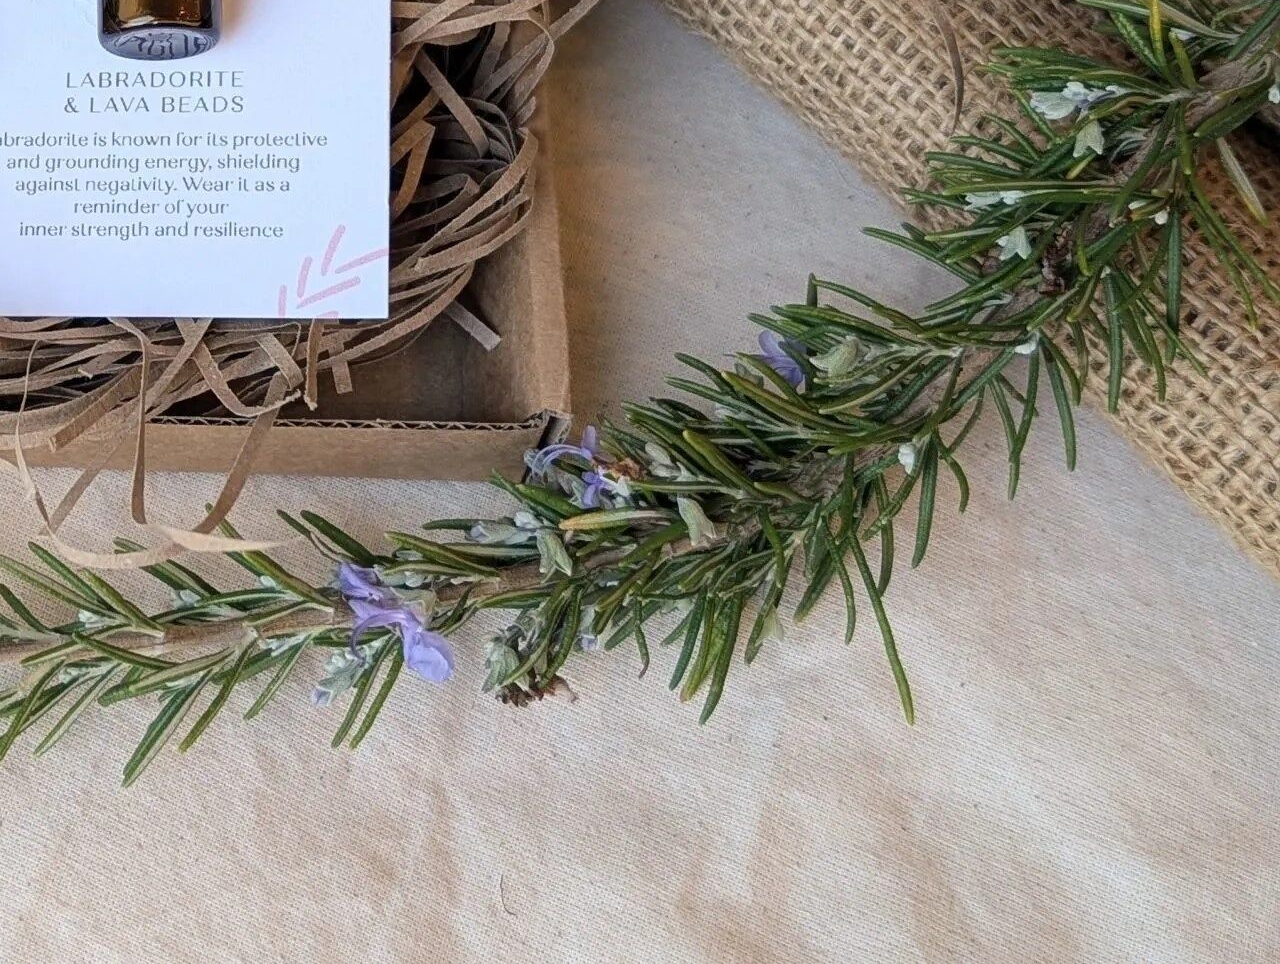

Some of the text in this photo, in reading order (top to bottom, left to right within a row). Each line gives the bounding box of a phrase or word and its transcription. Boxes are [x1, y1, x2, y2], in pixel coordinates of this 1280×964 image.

[65, 70, 245, 89] LABRADORITE
[64, 96, 245, 114] & LAVA BEADS
[93, 131, 107, 147] is
[111, 132, 171, 147] known
[176, 131, 203, 147] for
[207, 132, 228, 147] its
[232, 132, 328, 149] protective
[6, 154, 300, 173] and grounding energy, shielding
[15, 177, 290, 195] against negativity. Wear it as a
[73, 199, 230, 218] reminder of your
[19, 222, 284, 241] inner strength and resilience
